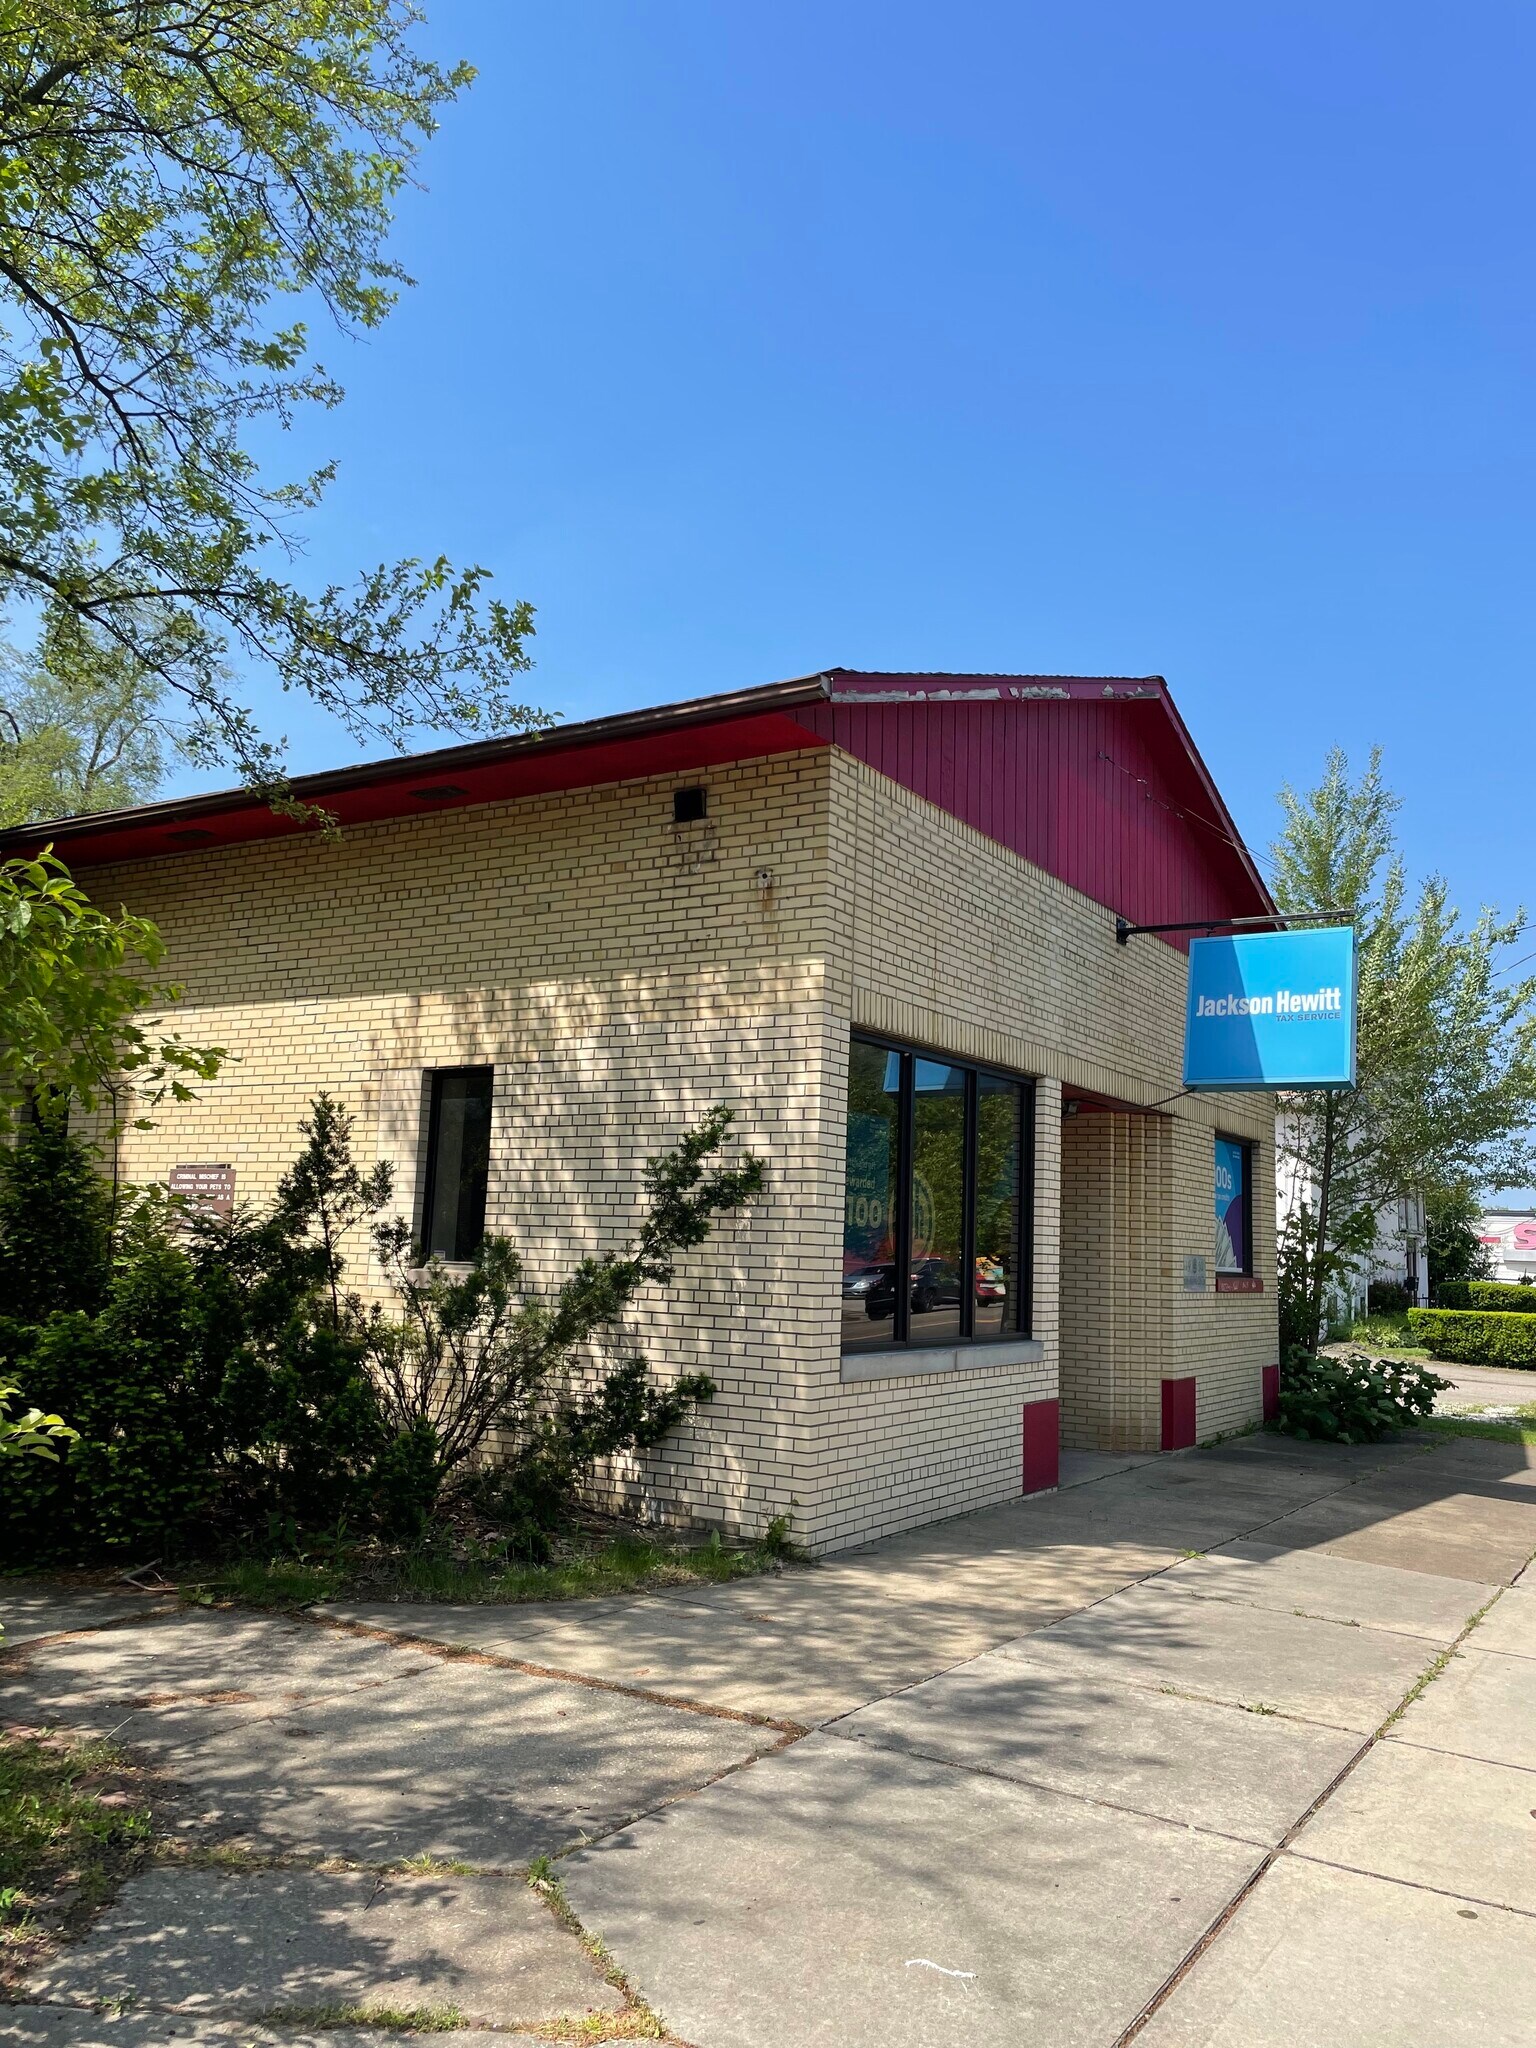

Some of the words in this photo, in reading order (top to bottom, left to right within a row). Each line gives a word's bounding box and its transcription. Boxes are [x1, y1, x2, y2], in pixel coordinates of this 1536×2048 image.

[1196, 994, 1273, 1017] Jackson
[1276, 987, 1342, 1014] Hewitt
[1276, 1014, 1294, 1022] TAX
[1297, 1011, 1341, 1022] SERVICE
